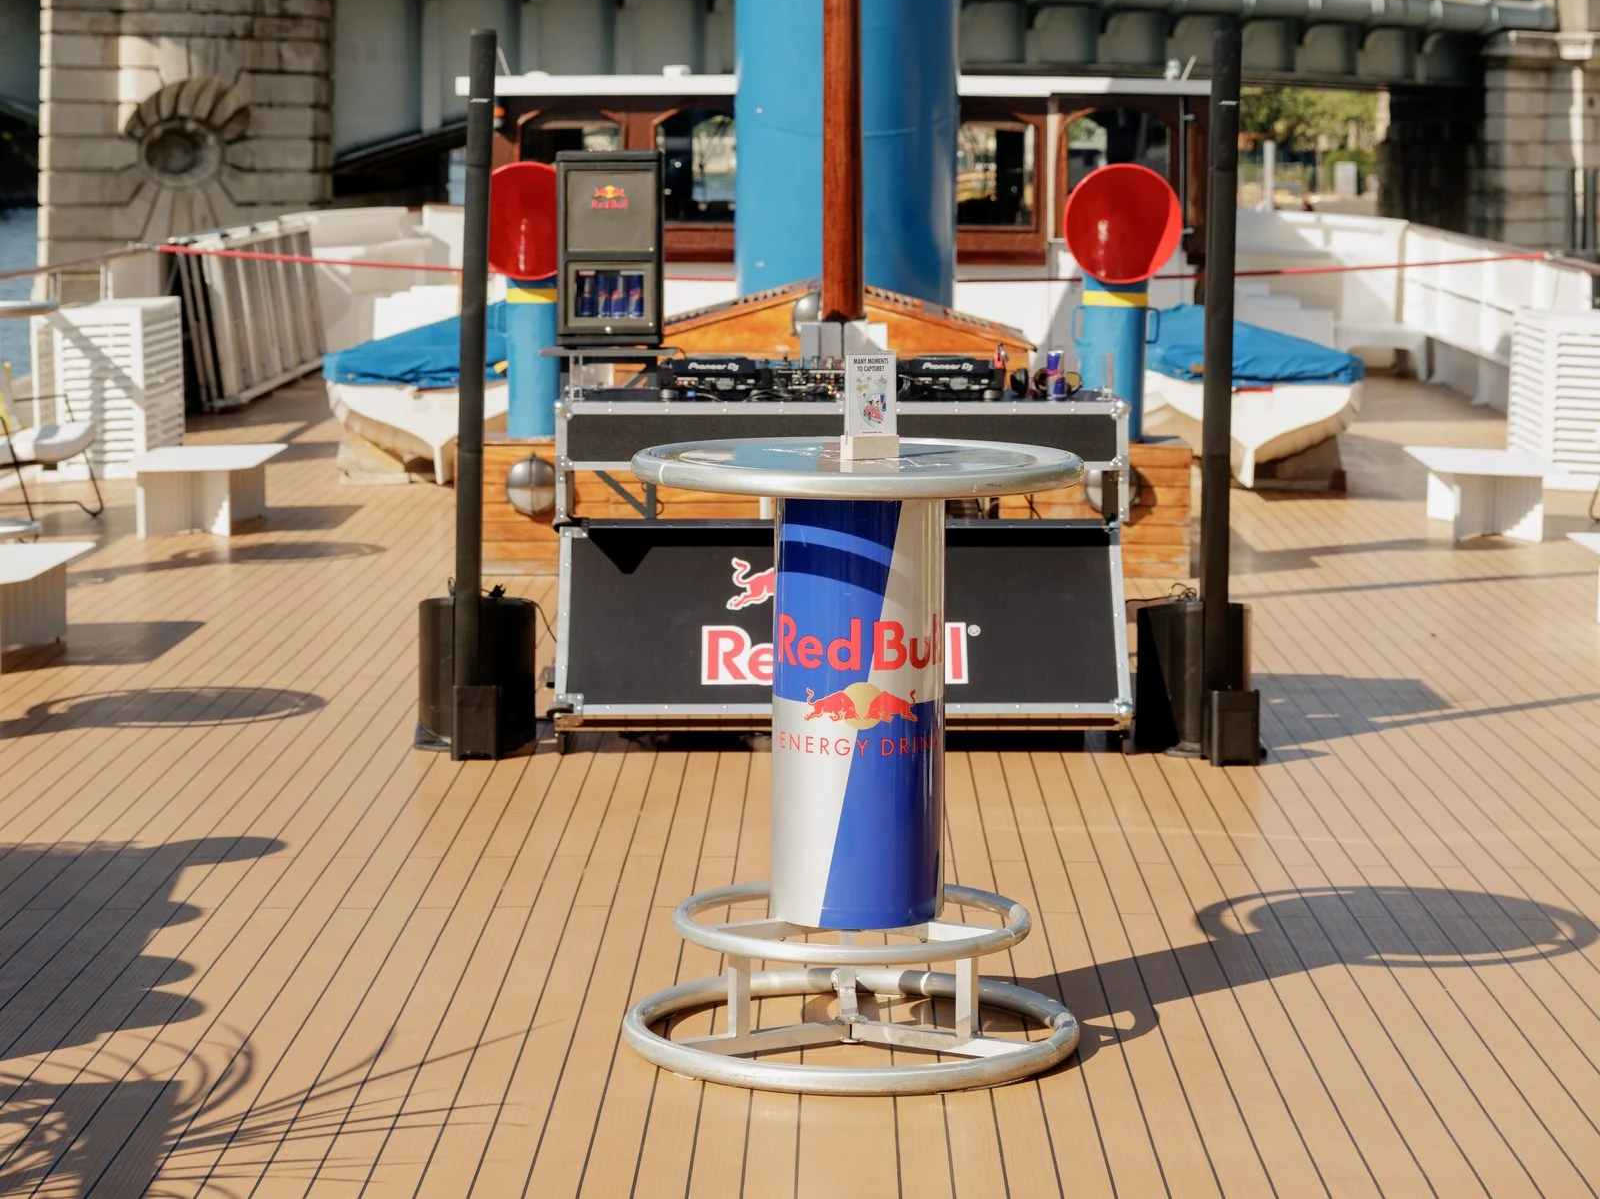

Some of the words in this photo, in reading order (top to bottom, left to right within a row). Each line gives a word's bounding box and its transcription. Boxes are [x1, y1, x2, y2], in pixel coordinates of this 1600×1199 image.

[687, 362, 727, 370] Pioneer
[922, 362, 961, 370] Pioneer
[702, 625, 773, 685] Re
[776, 613, 862, 671] Red
[873, 612, 943, 671] Bull
[779, 730, 867, 757] ENERGY
